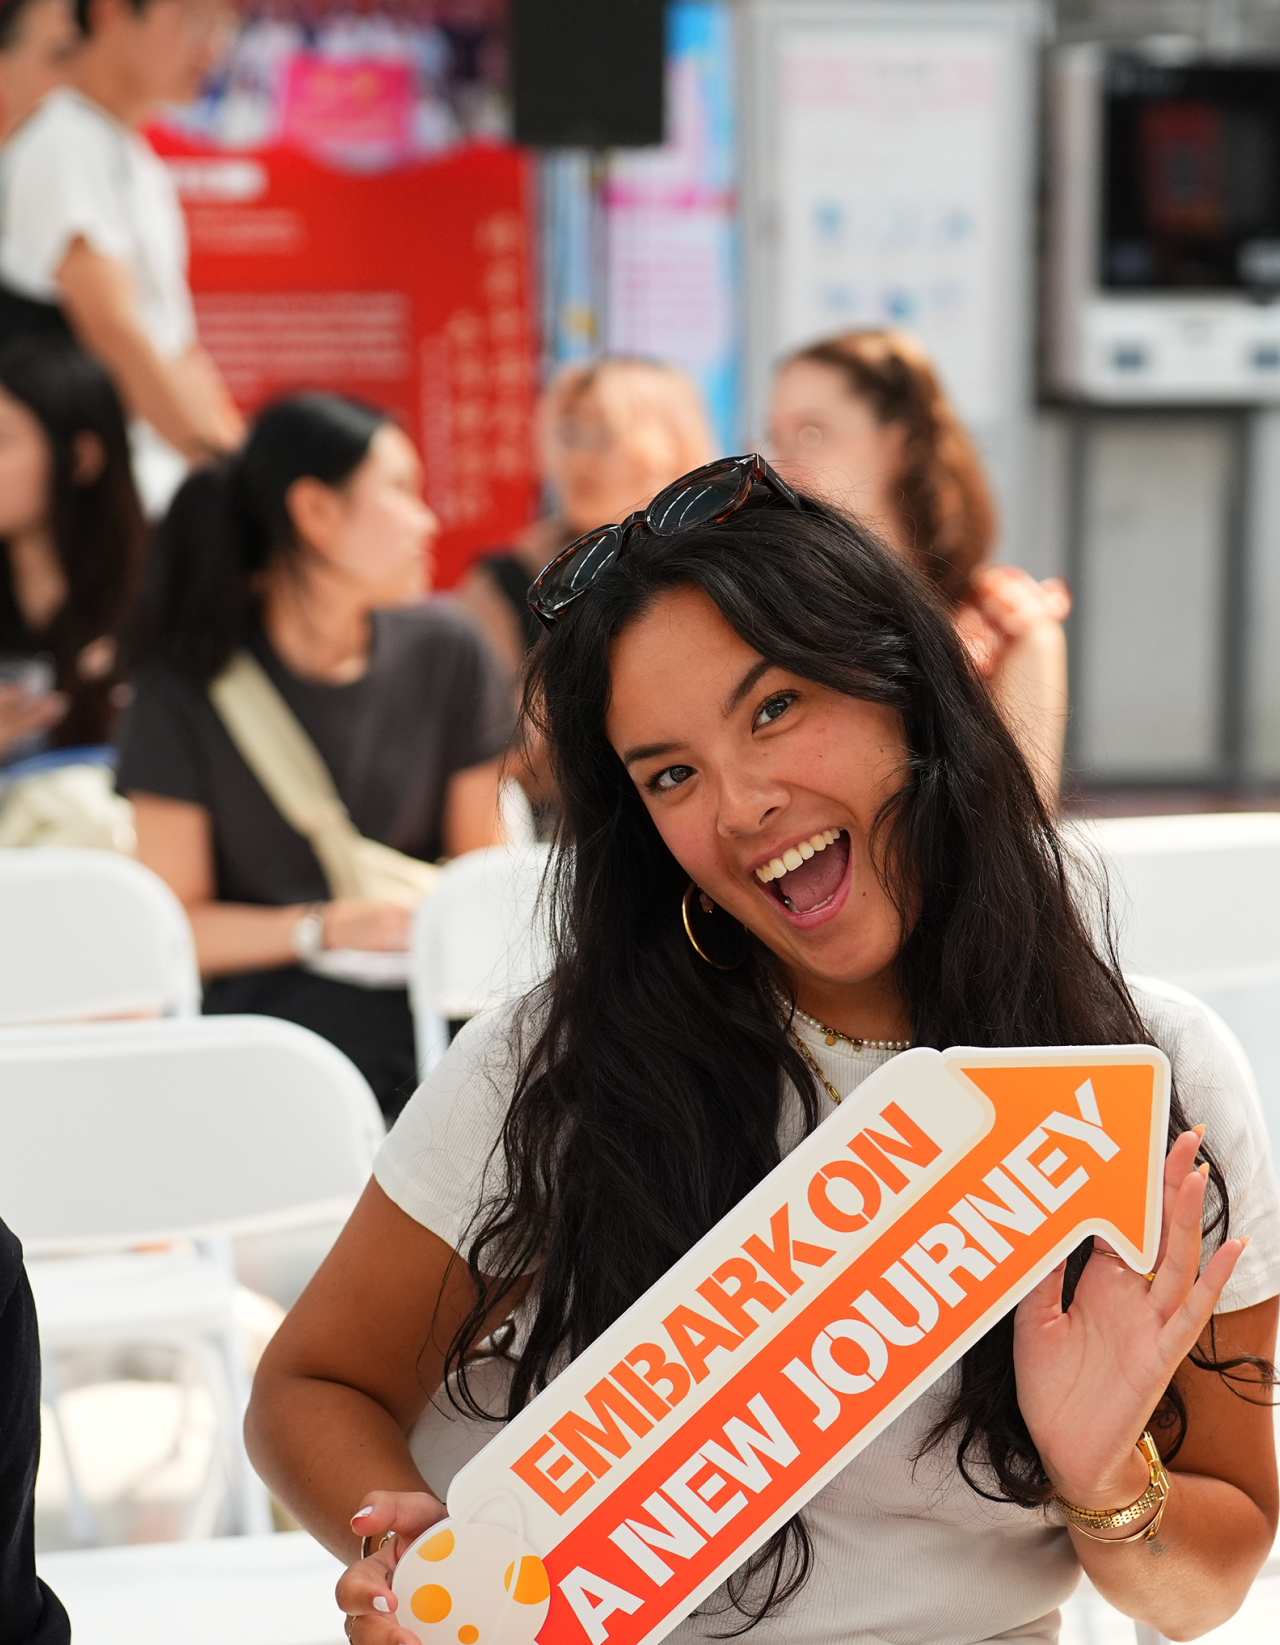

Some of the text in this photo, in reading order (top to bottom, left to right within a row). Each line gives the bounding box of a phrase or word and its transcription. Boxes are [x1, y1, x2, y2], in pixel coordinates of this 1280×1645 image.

[510, 1101, 944, 1517] EMBARK ON
[557, 1078, 1123, 1645] A NEW JOURNEY
